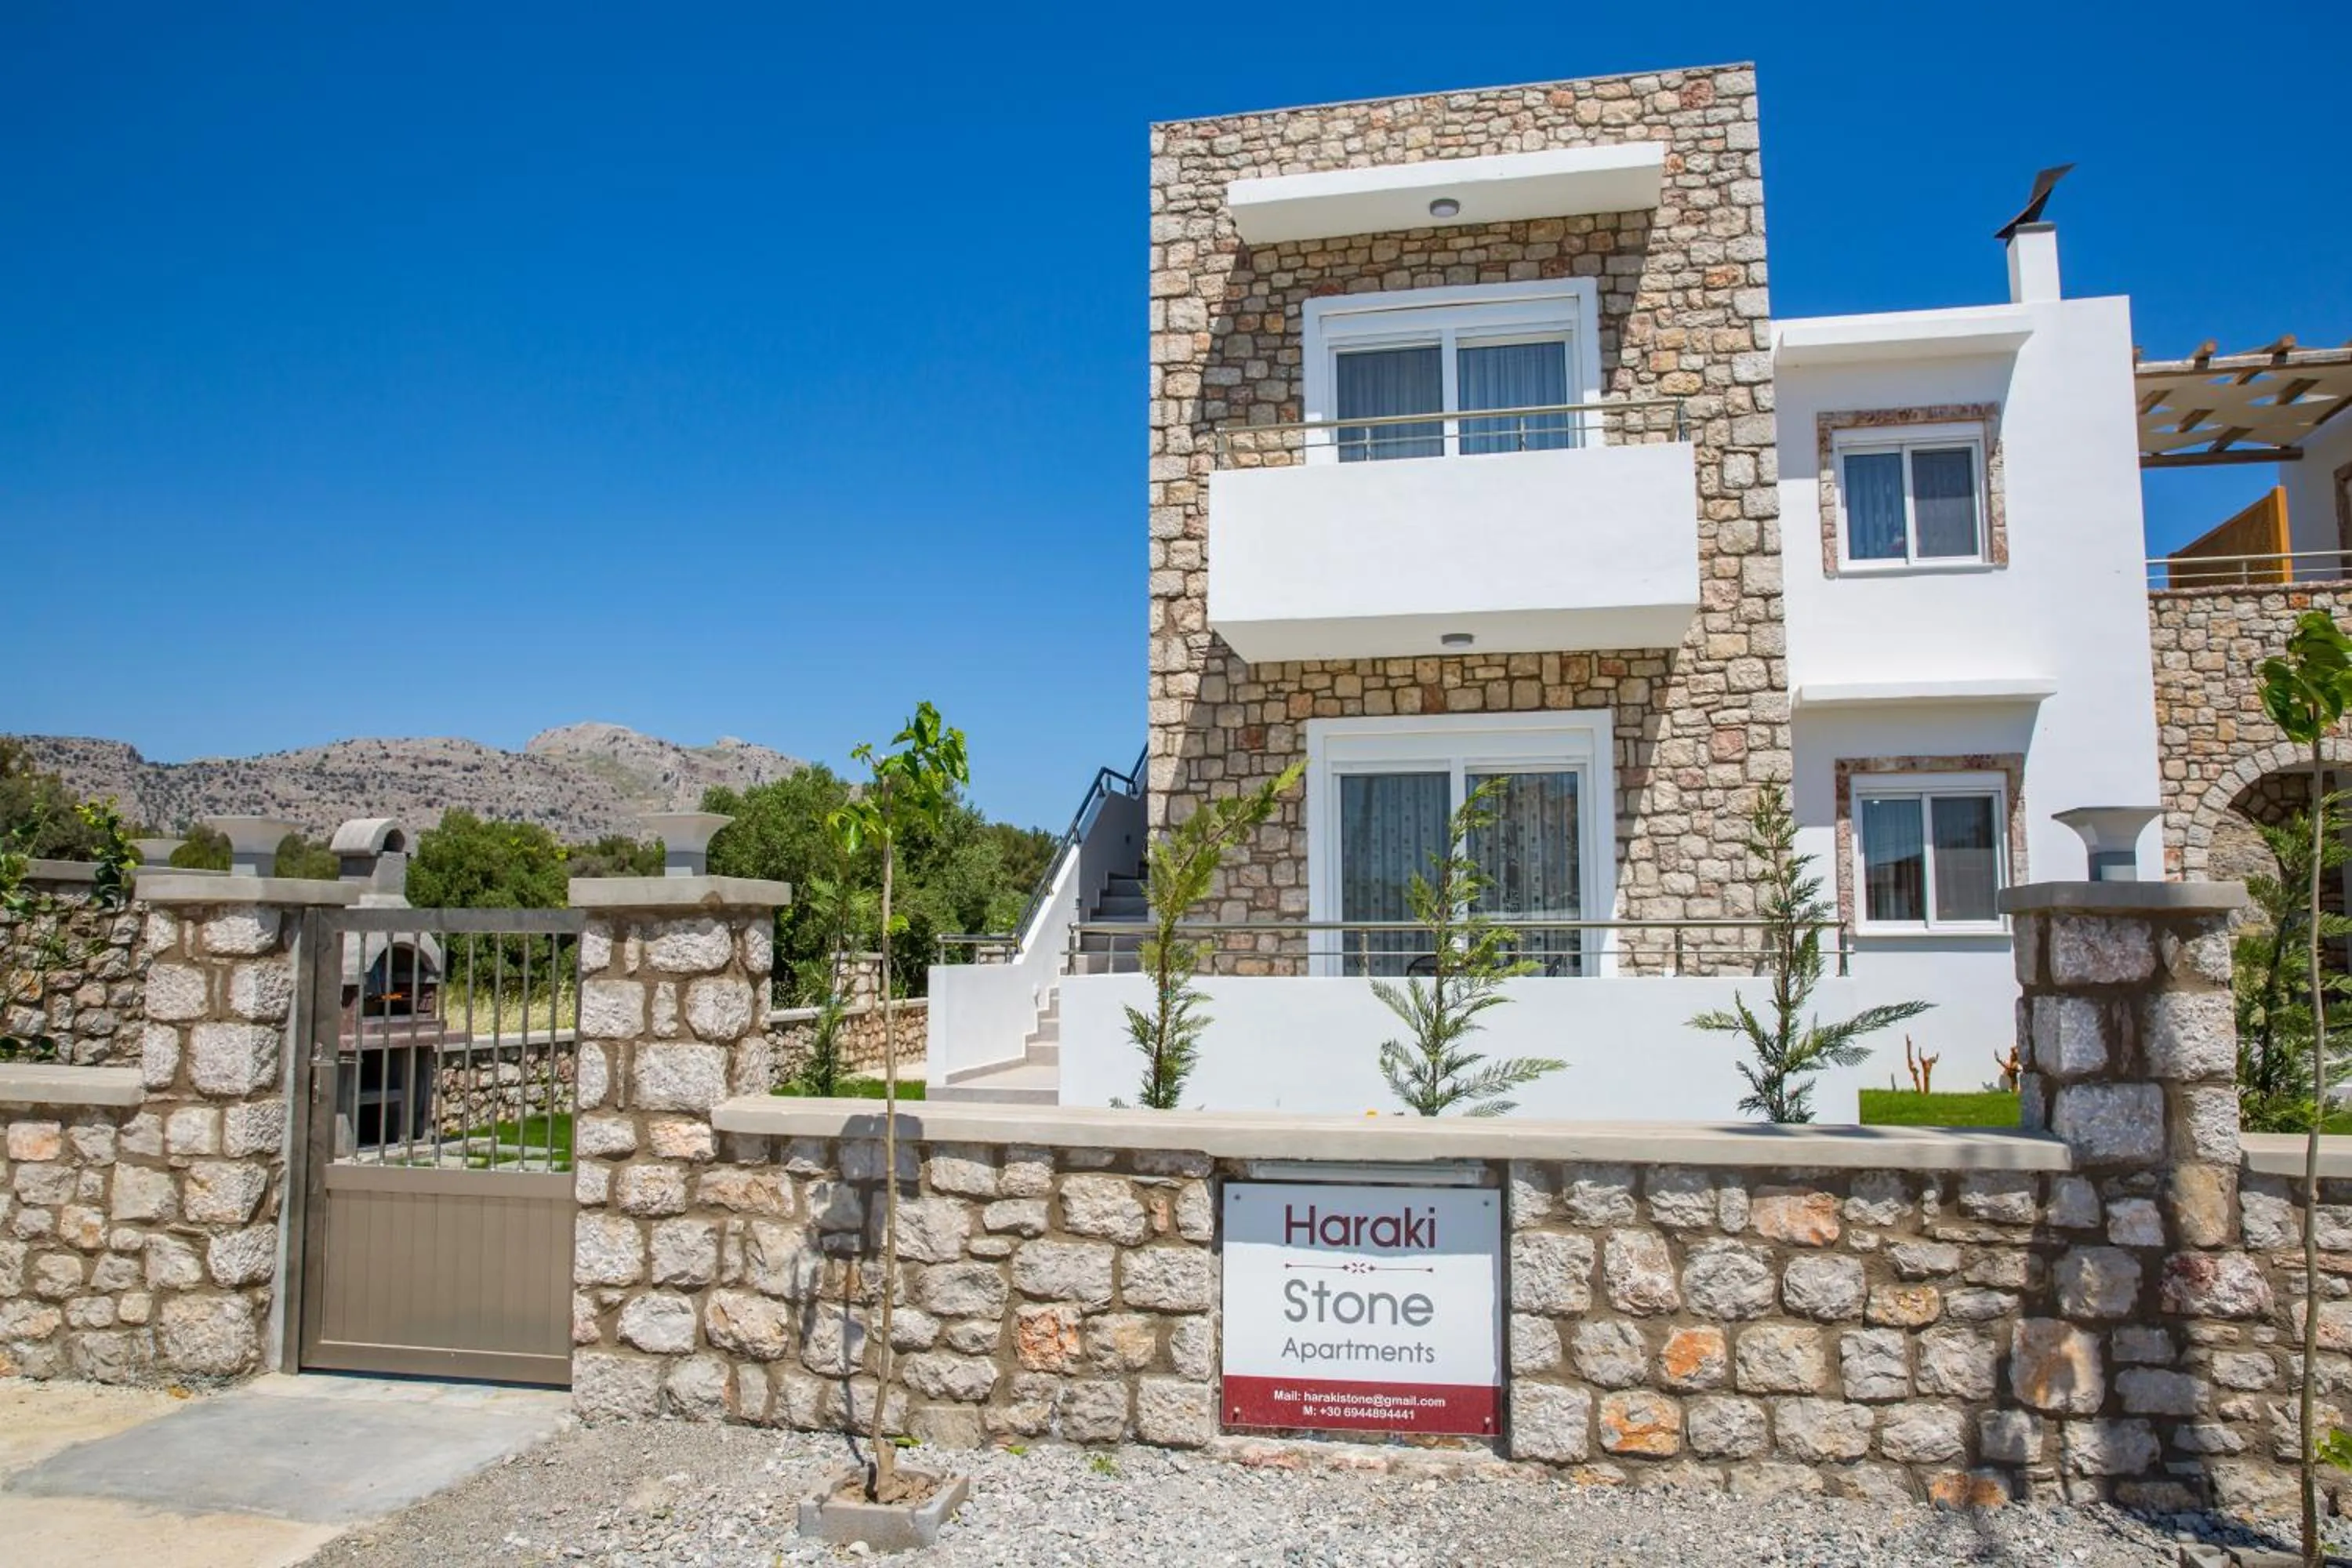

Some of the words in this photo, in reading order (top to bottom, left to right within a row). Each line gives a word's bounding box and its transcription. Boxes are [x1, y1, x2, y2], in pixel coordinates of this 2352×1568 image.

[1285, 1204, 1436, 1248] Haraki
[1283, 1279, 1434, 1327] Stone
[1281, 1337, 1435, 1363] Apartments
[1274, 1390, 1301, 1402] Mail:
[1304, 1392, 1446, 1407] harakistone@gmail.com
[1303, 1406, 1316, 1417] M:
[1319, 1406, 1341, 1417] +30
